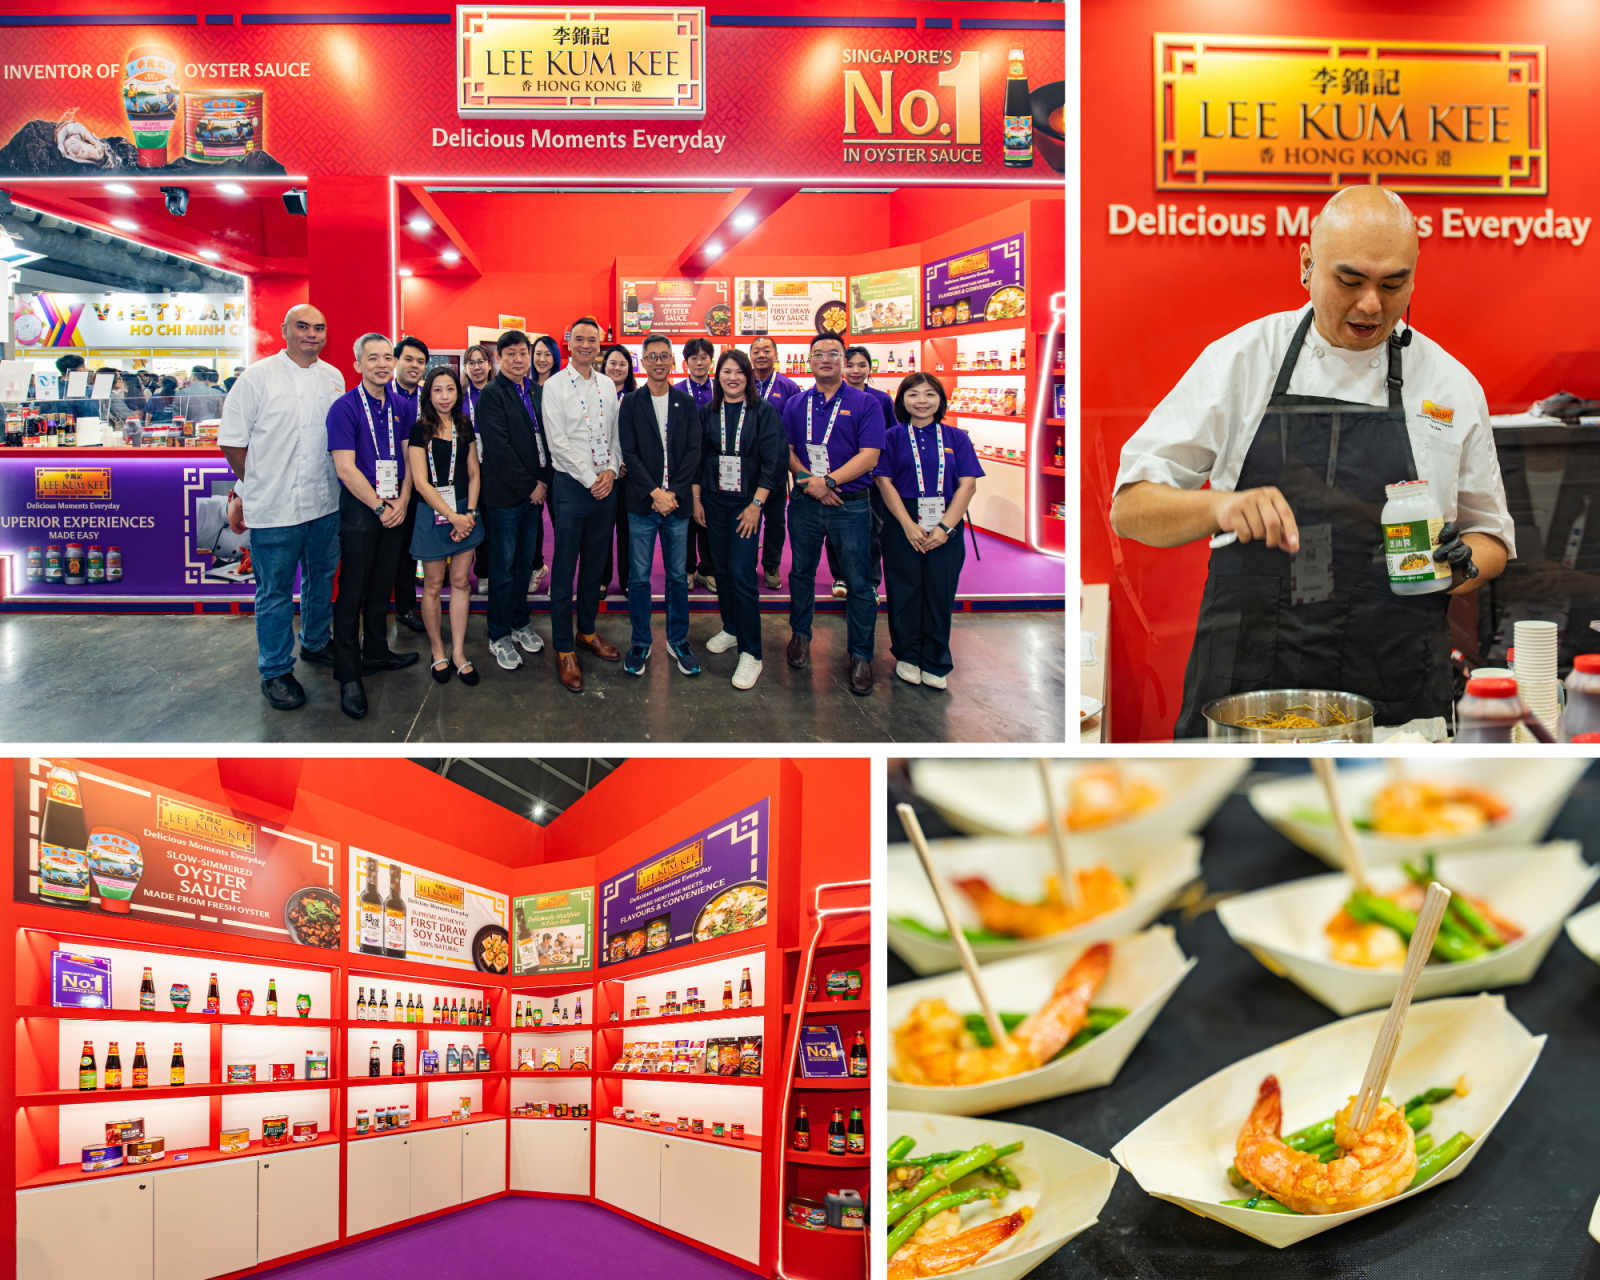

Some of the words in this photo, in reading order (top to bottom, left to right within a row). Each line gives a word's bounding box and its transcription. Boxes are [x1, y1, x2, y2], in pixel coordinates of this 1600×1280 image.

[552, 26, 610, 46] 李錦記
[485, 50, 533, 76] LEE
[546, 50, 617, 76] KUM
[626, 50, 679, 76] KEE
[842, 49, 953, 65] SINGAPORE'S
[4, 64, 93, 79] INVENTOR
[96, 64, 120, 79] OF
[184, 63, 251, 78] OYSTER
[254, 62, 311, 78] SAUCE
[521, 80, 532, 92] 香
[537, 80, 581, 92] HONG
[584, 80, 627, 92] KONG
[631, 80, 643, 93] 港
[1310, 67, 1401, 97] 李錦記
[842, 50, 982, 145] No.1
[1198, 100, 1279, 140] LEE
[1298, 102, 1415, 142] KUM
[1427, 104, 1511, 143] KEE
[431, 128, 525, 148] Delicious
[531, 129, 627, 149] Moments
[632, 129, 726, 154] Everyday
[843, 148, 863, 162] IN
[864, 148, 928, 163] OYSTER
[930, 148, 983, 163] SAUCE
[1259, 147, 1276, 164] 香
[1284, 147, 1354, 165] HONG
[1362, 148, 1428, 167] KONG
[1436, 149, 1452, 167] 港
[1108, 204, 1266, 237] Delicious
[1442, 208, 1592, 246] Everyday
[965, 280, 1003, 293] CONVENIENCE
[130, 324, 153, 336] HO
[156, 324, 182, 336] CHI
[185, 324, 225, 336] MINH
[229, 324, 245, 336] CI
[43, 480, 59, 490] LEE
[62, 480, 85, 490] KUM
[87, 480, 104, 490] KEE
[26, 502, 57, 510] Delicious
[57, 502, 89, 510] Moments
[89, 502, 120, 511] Everyday
[63, 516, 155, 528] EXPERIENCES
[49, 531, 76, 540] MADE
[77, 531, 100, 540] EASY
[168, 812, 191, 826] LEE
[195, 820, 224, 836] KUM
[227, 829, 248, 842] KEE
[143, 829, 187, 846] Delicious
[188, 840, 229, 857] Moments
[230, 851, 267, 867] Everyday
[166, 850, 253, 877] SLOW-SIMMERED
[173, 863, 247, 890] OYSTER
[653, 879, 681, 894] Moments
[681, 865, 712, 882] Everyday
[682, 880, 703, 892] MEETS
[180, 880, 241, 903] SAUCE
[620, 905, 656, 924] FLAVOURS
[662, 878, 726, 908] CONVENIENCE
[143, 888, 175, 901] MADE
[177, 895, 206, 907] FROM
[207, 899, 236, 912] FRESH
[237, 906, 270, 918] OYSTER
[410, 916, 438, 931] FIRST
[439, 923, 467, 937] DRAW
[412, 910, 436, 920] SUPREME
[438, 916, 465, 926] AUTHENTIC
[527, 914, 556, 923] Deliciously
[556, 911, 582, 919] Healthier
[412, 928, 433, 941] SOY
[435, 933, 465, 947] SAUCE
[435, 943, 459, 952] NATURAL
[62, 975, 102, 991] No.1
[806, 1042, 838, 1058] No.1
